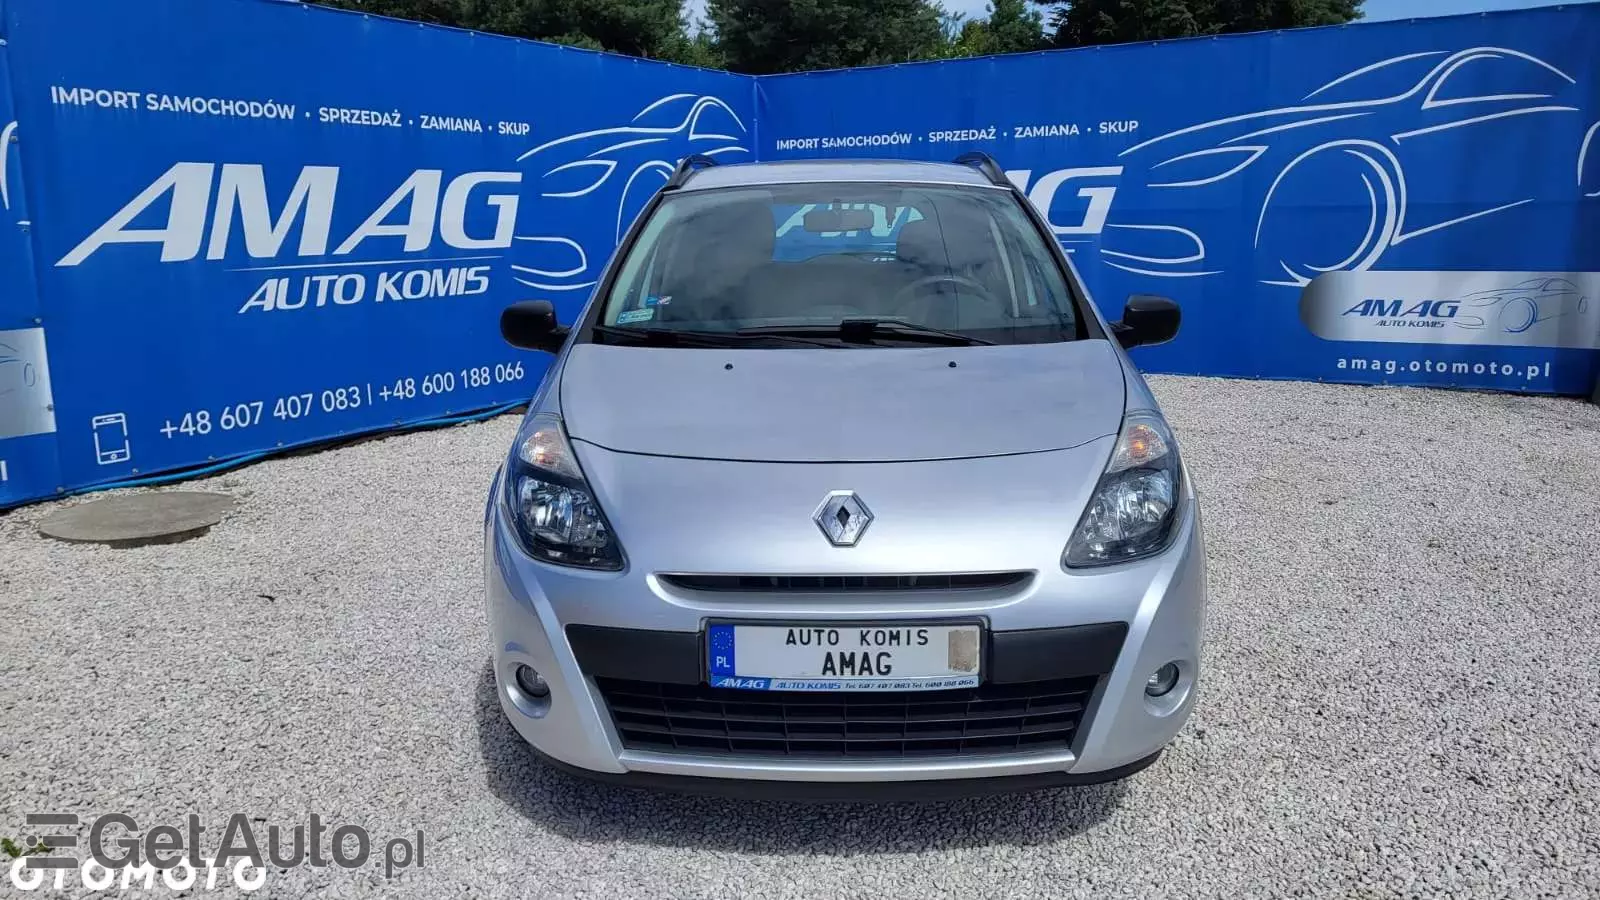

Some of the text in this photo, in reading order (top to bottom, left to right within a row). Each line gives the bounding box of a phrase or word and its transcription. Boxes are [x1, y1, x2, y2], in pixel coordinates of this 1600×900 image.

[51, 86, 530, 136] IMPORT SAMOCHODÓW SPRZEDAŻ ZAMIANA SKUP
[776, 120, 1139, 151] IMPORT SAMOCHODÓW SPRZEDAŻ ZAMIANA SKUP
[54, 162, 522, 267] AMAG
[239, 266, 491, 313] AUTO KOMIS
[1341, 299, 1461, 318] AMAG
[1408, 320, 1445, 328] KOMIS
[1337, 357, 1550, 379] amag.otomoto.pl
[160, 361, 525, 439] +48 607 407 083 +48 600 188 066
[786, 629, 929, 646] AUTO KOMIS
[716, 656, 730, 668] PL
[822, 652, 892, 676] AMAG
[716, 678, 765, 689] AMAG
